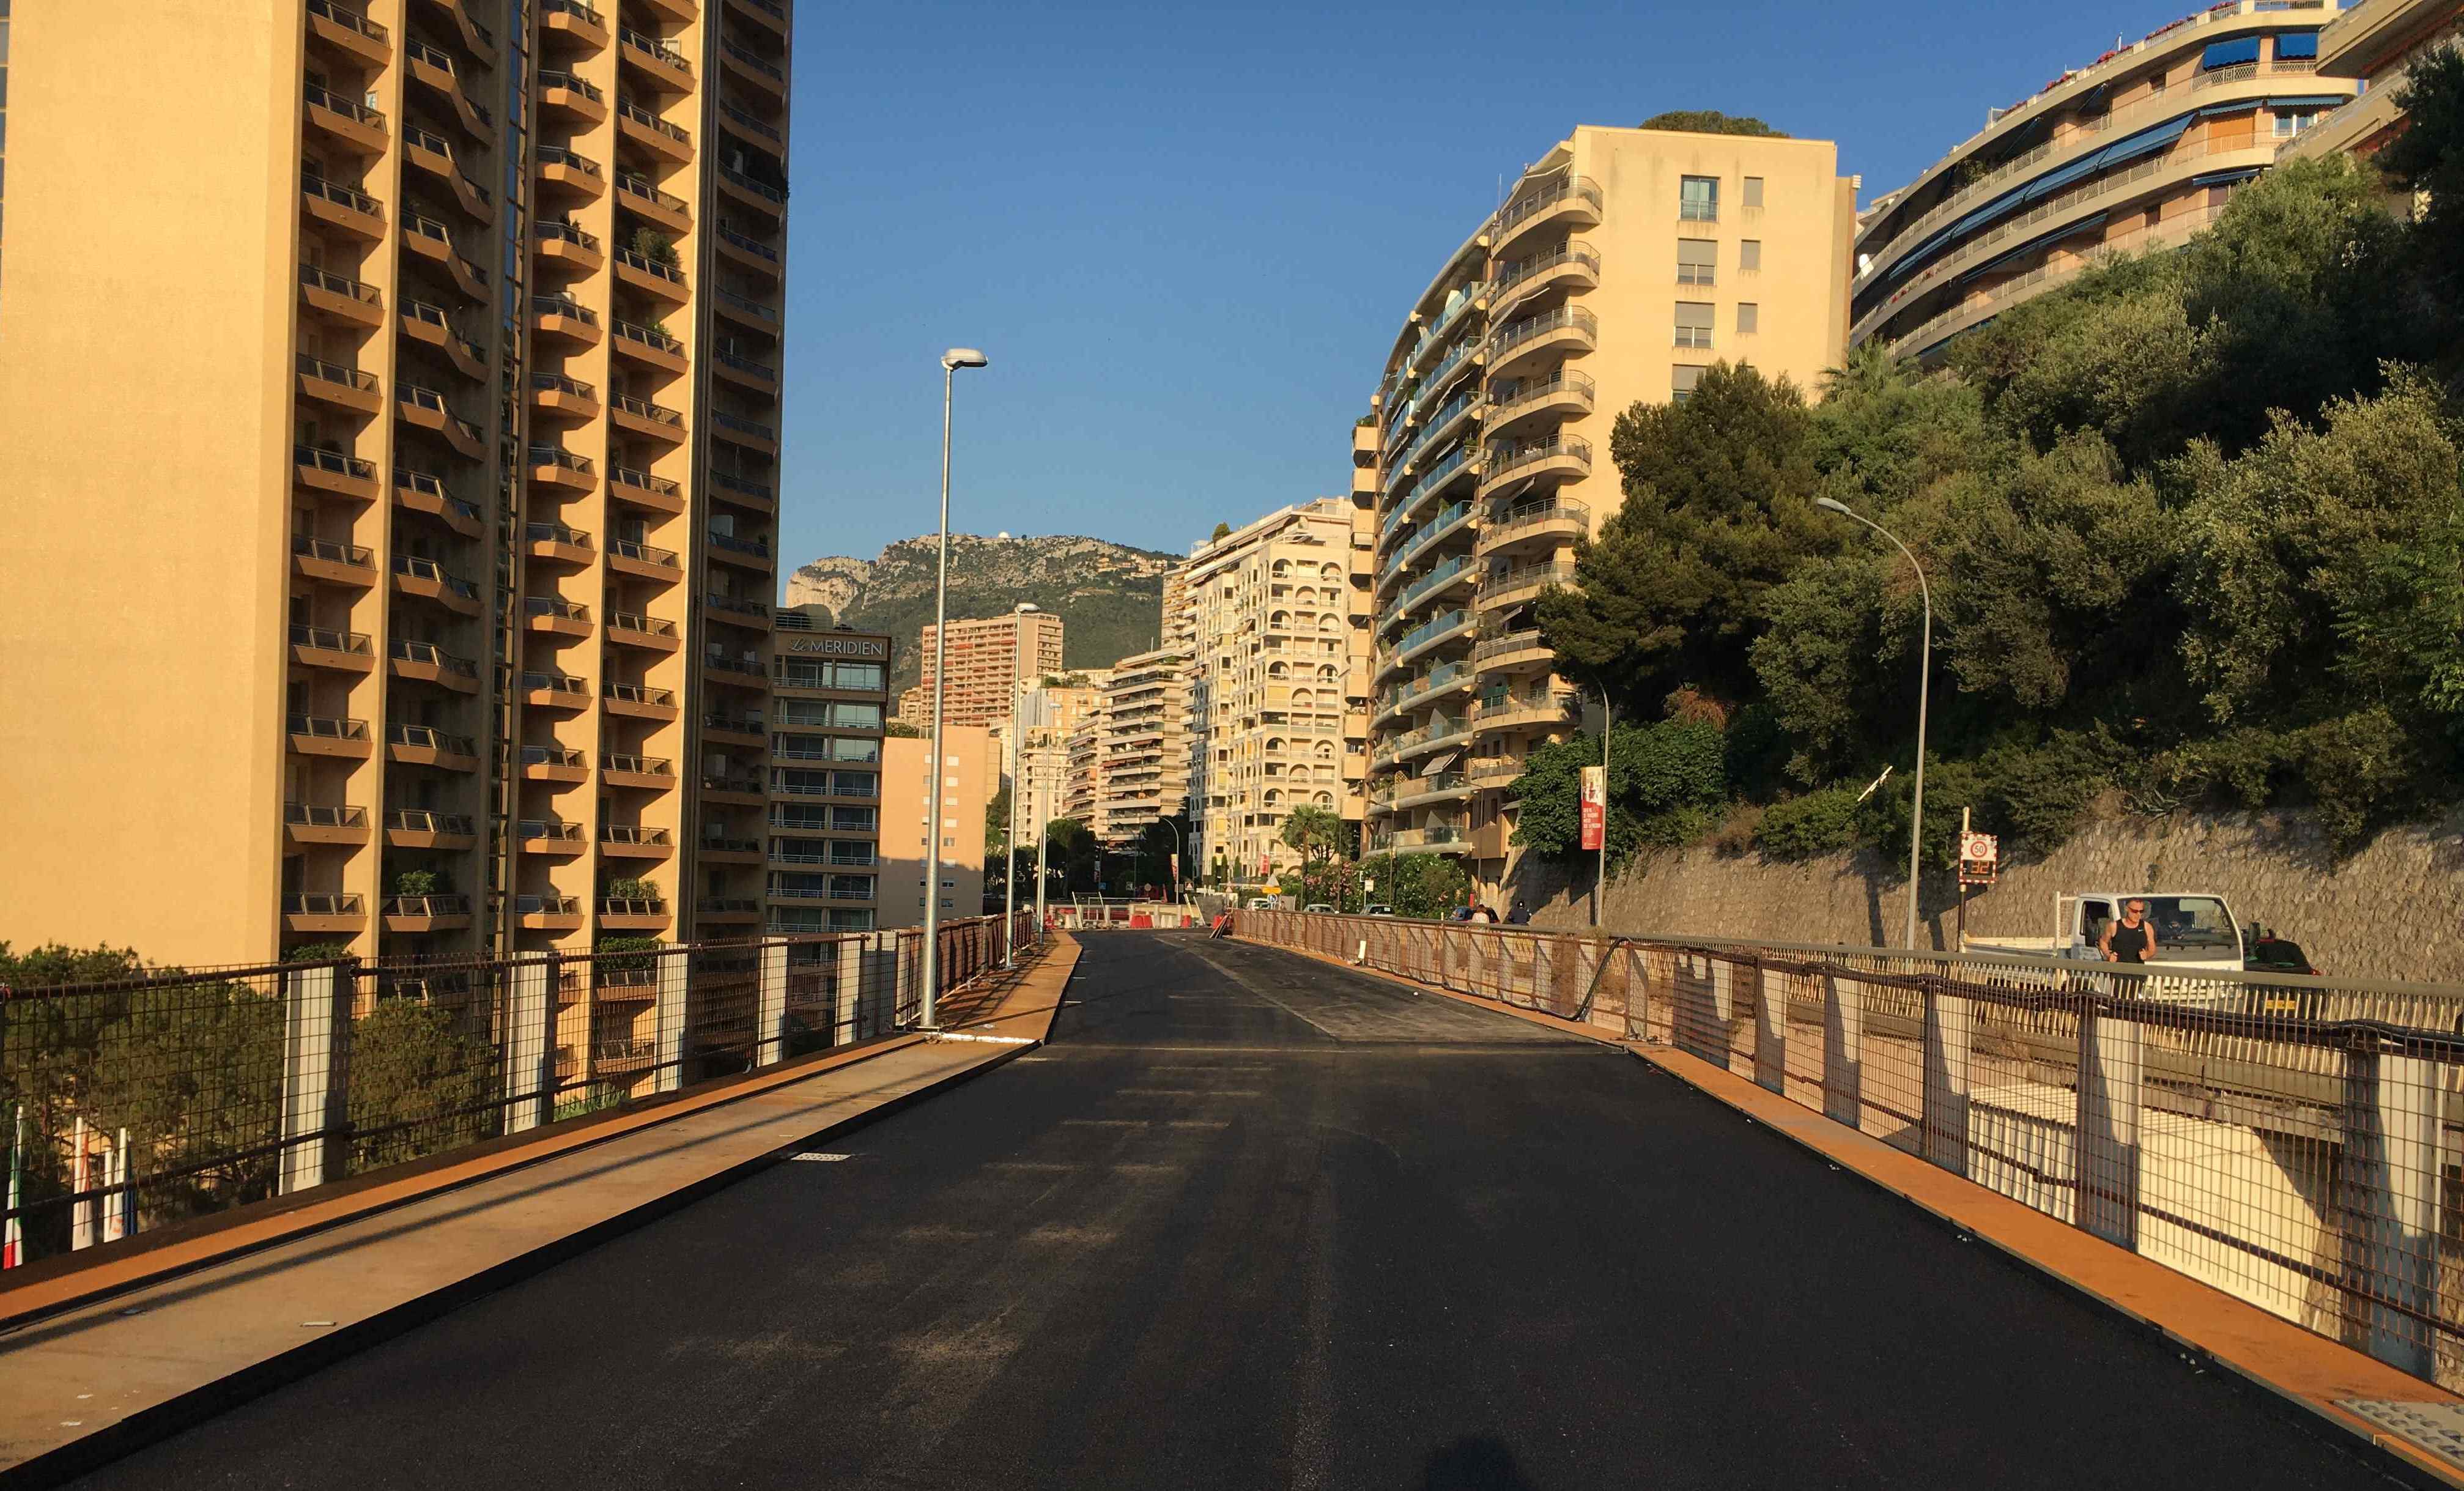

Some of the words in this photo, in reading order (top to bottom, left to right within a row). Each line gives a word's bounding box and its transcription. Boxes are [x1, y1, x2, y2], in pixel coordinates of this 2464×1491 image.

[810, 640, 882, 656] MERIDIEN
[1975, 845, 1983, 854] 50
[1971, 860, 1989, 873] 32
